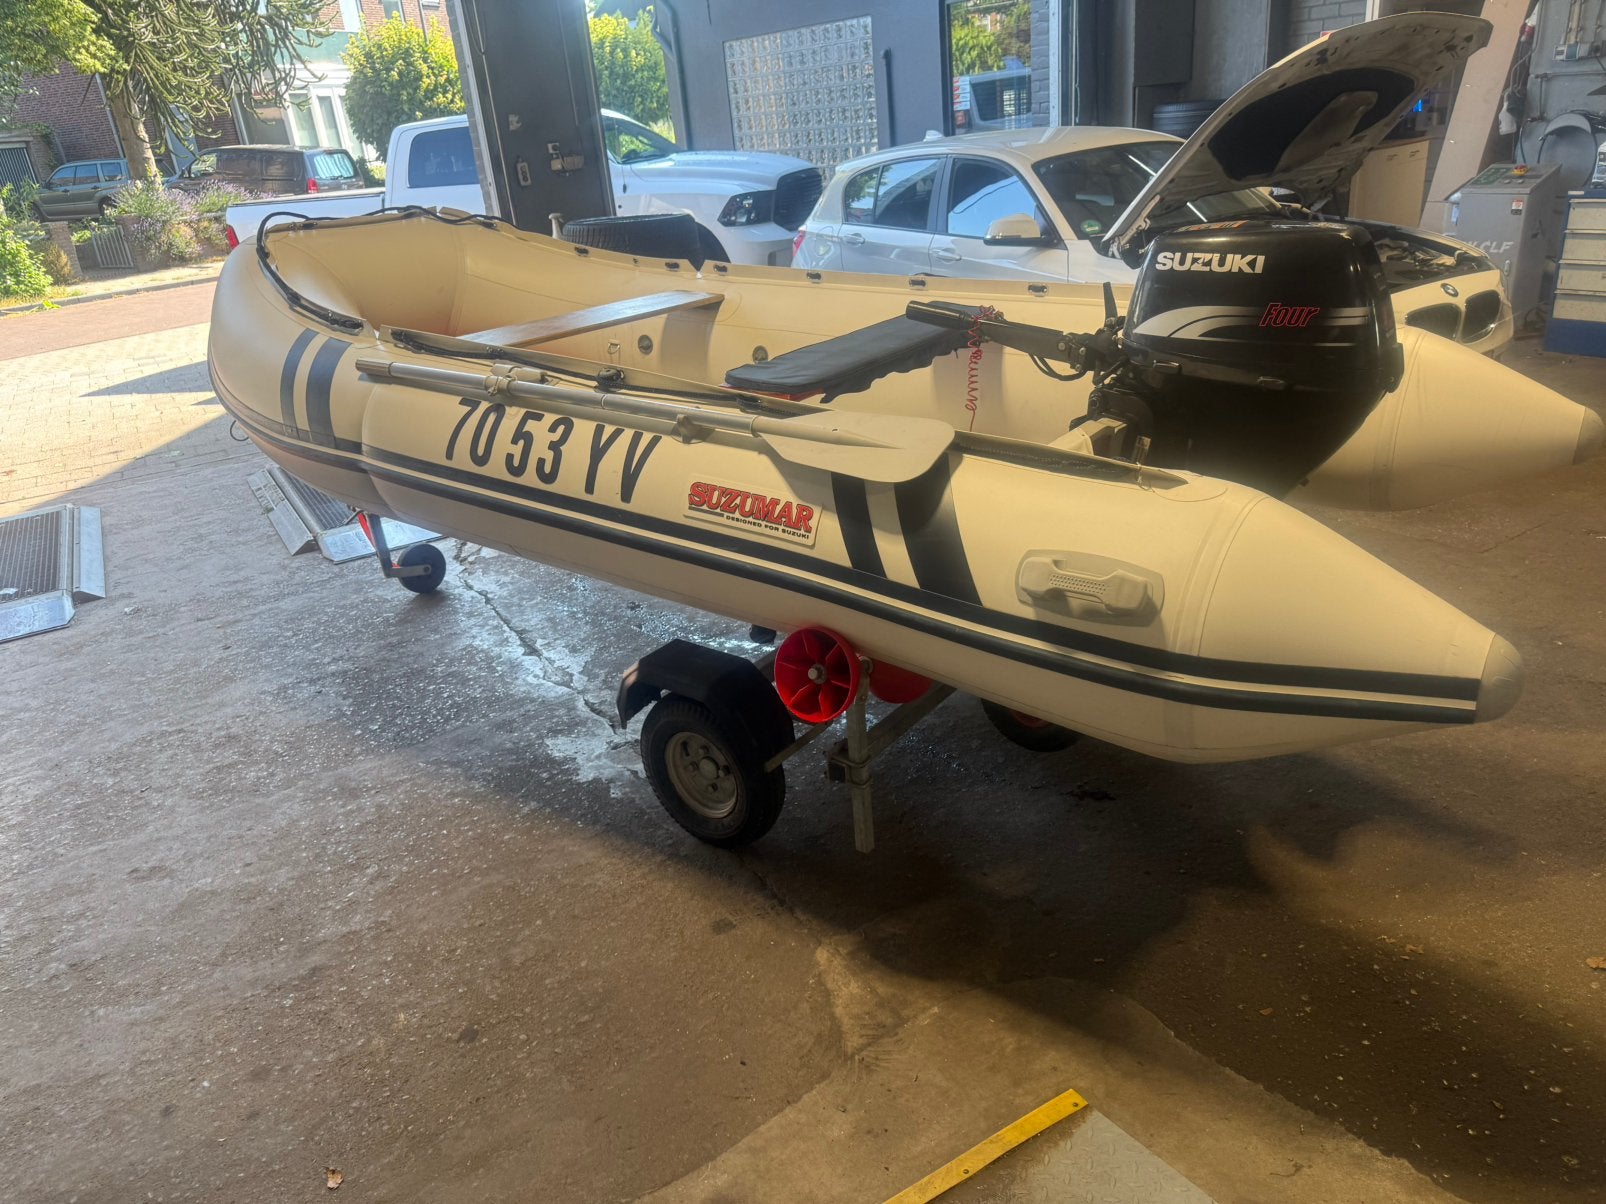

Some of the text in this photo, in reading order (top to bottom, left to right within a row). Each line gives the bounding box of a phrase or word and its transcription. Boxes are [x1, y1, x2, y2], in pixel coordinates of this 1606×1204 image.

[1155, 252, 1265, 274] SUZUKI
[1259, 302, 1320, 327] Four
[584, 423, 662, 504] YV
[688, 481, 815, 533] SUZUMAR
[726, 515, 810, 540] DESIGNED FOR SUZUKI
